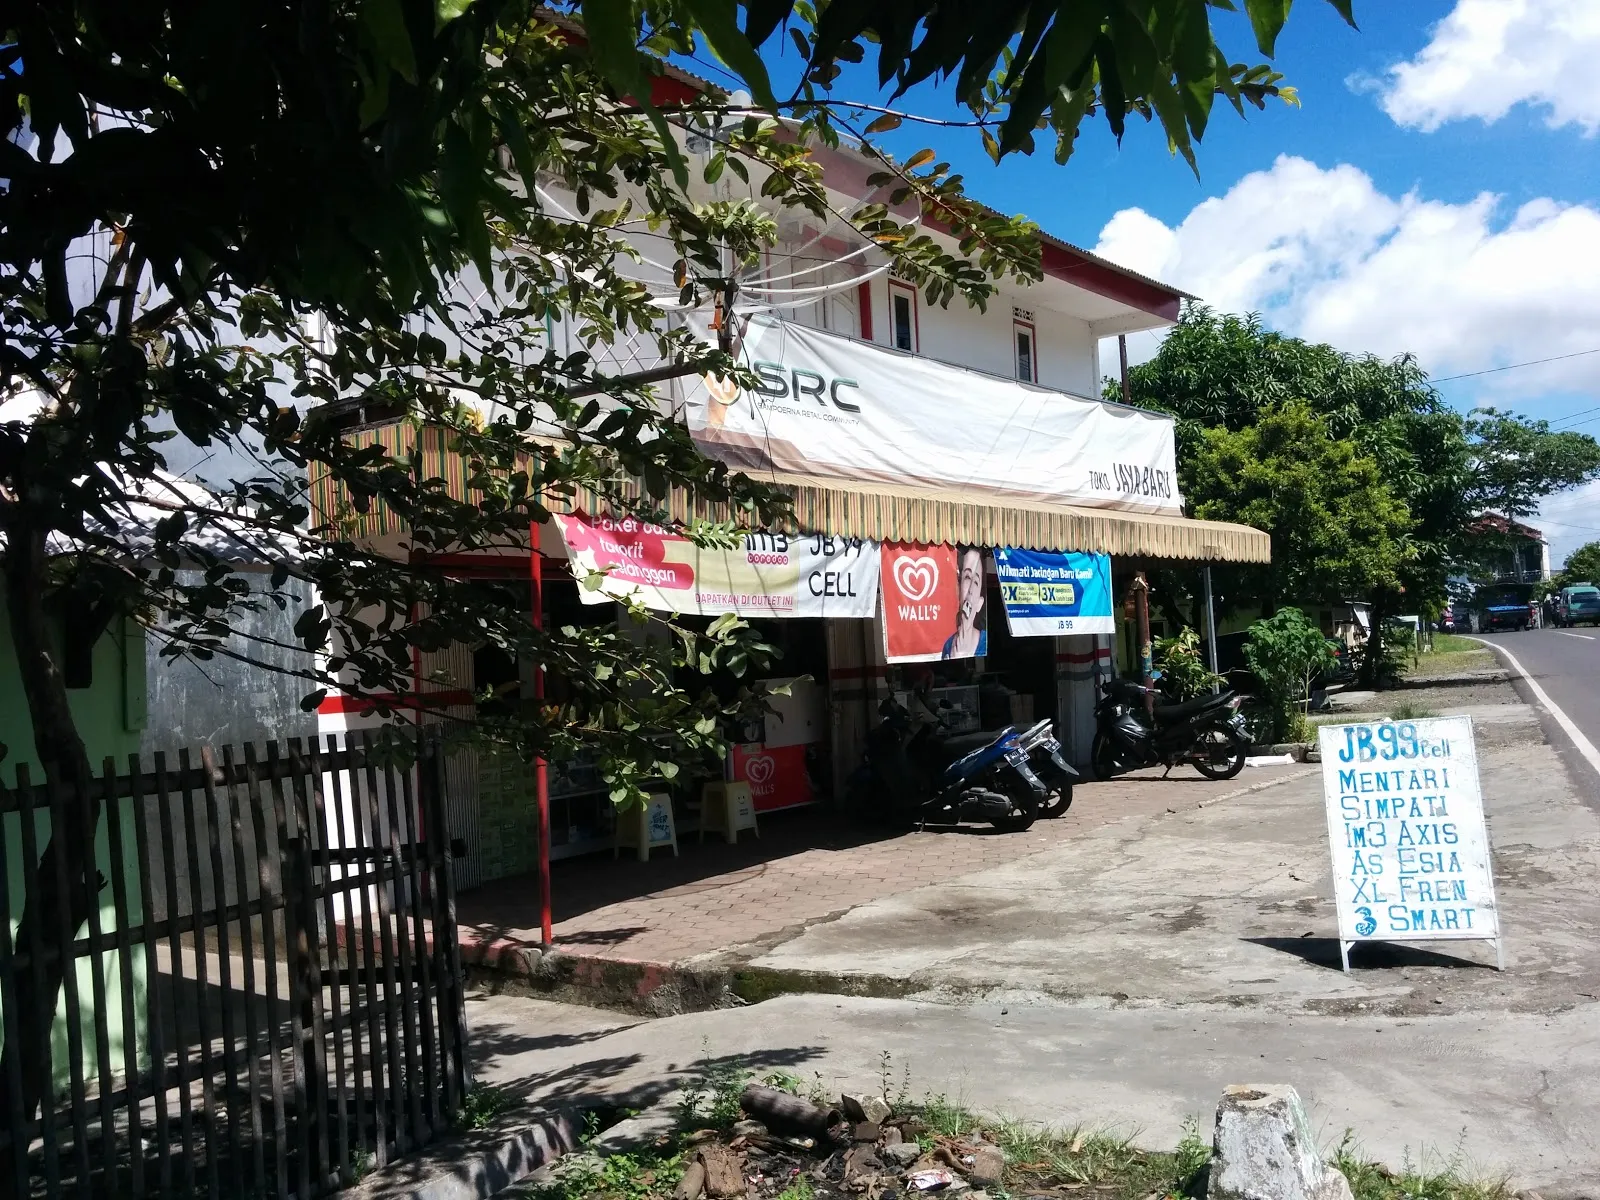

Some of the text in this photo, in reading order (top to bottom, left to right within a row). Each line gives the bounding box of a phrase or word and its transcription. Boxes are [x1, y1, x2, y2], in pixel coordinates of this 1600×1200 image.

[754, 360, 861, 413] SRC
[1089, 463, 1171, 499] TOKO JAYA BARU
[810, 532, 836, 556] JB
[748, 553, 788, 565] ooredoo
[808, 571, 857, 597] CELL
[999, 564, 1030, 577] Nikmati
[1031, 566, 1060, 581] Jaringan
[1060, 568, 1075, 579] Baru
[695, 592, 793, 606] DAPATKAN DI OUTLET INI
[1002, 586, 1018, 601] 2X
[1041, 587, 1056, 602] 3X
[897, 604, 938, 621] WALL'S
[1338, 768, 1450, 794] MENTARI
[1341, 796, 1450, 820] SIMPATI
[1398, 821, 1459, 846] AXIS
[1351, 848, 1463, 875] AS ESIA
[1350, 876, 1468, 903] XL FREN
[1388, 905, 1475, 931] SMART
